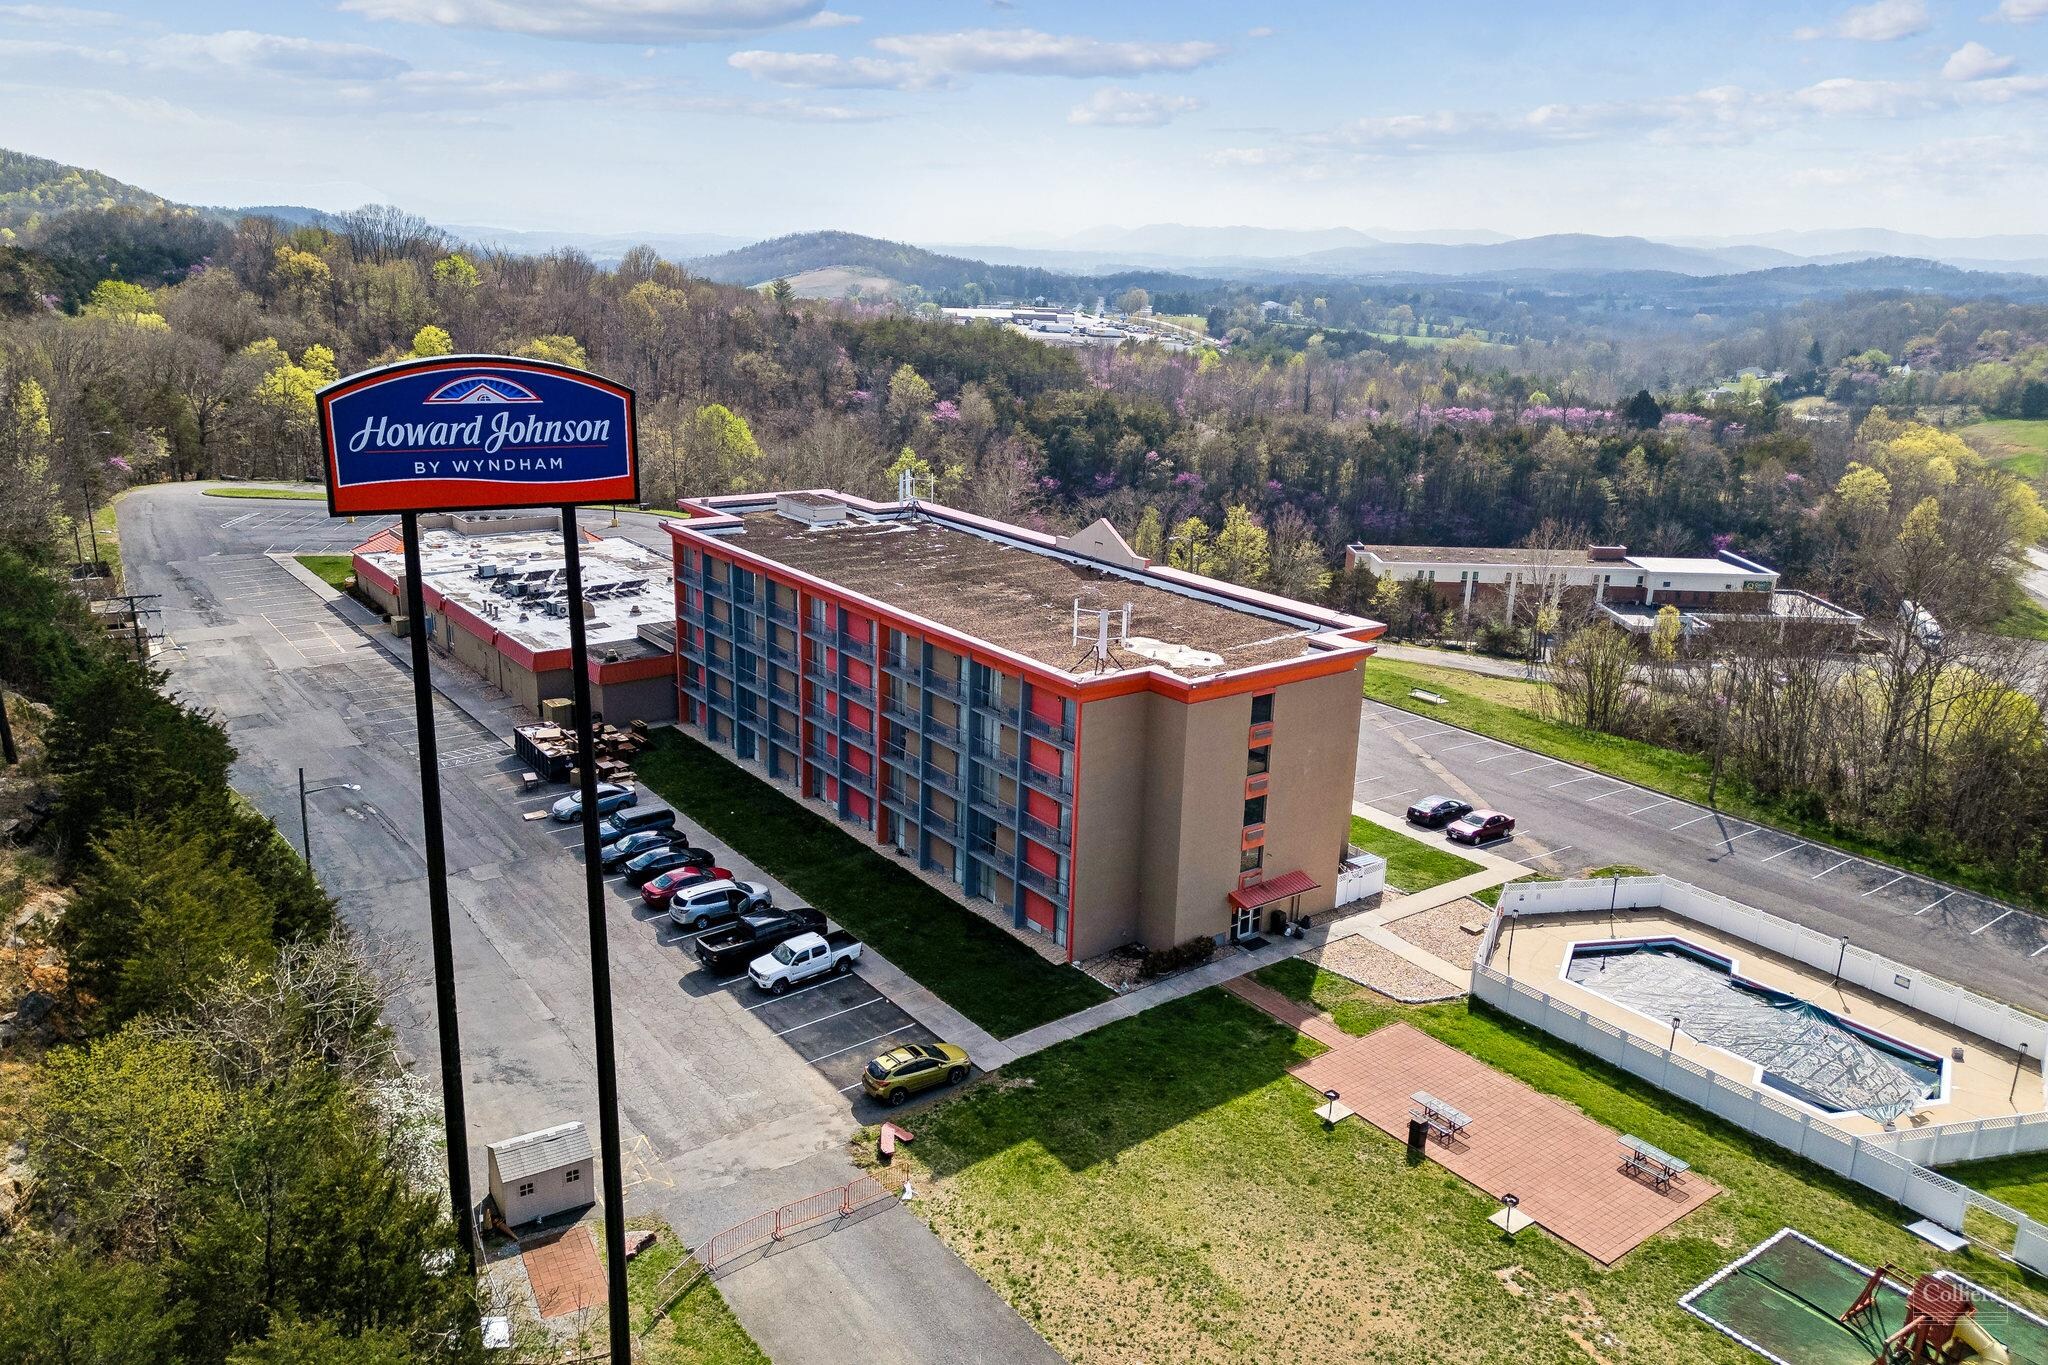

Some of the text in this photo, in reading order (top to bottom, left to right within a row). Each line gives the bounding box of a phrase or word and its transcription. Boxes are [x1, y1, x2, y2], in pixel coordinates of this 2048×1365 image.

[350, 411, 610, 454] Howard Johnson
[414, 457, 563, 474] BY WYNDHAM
